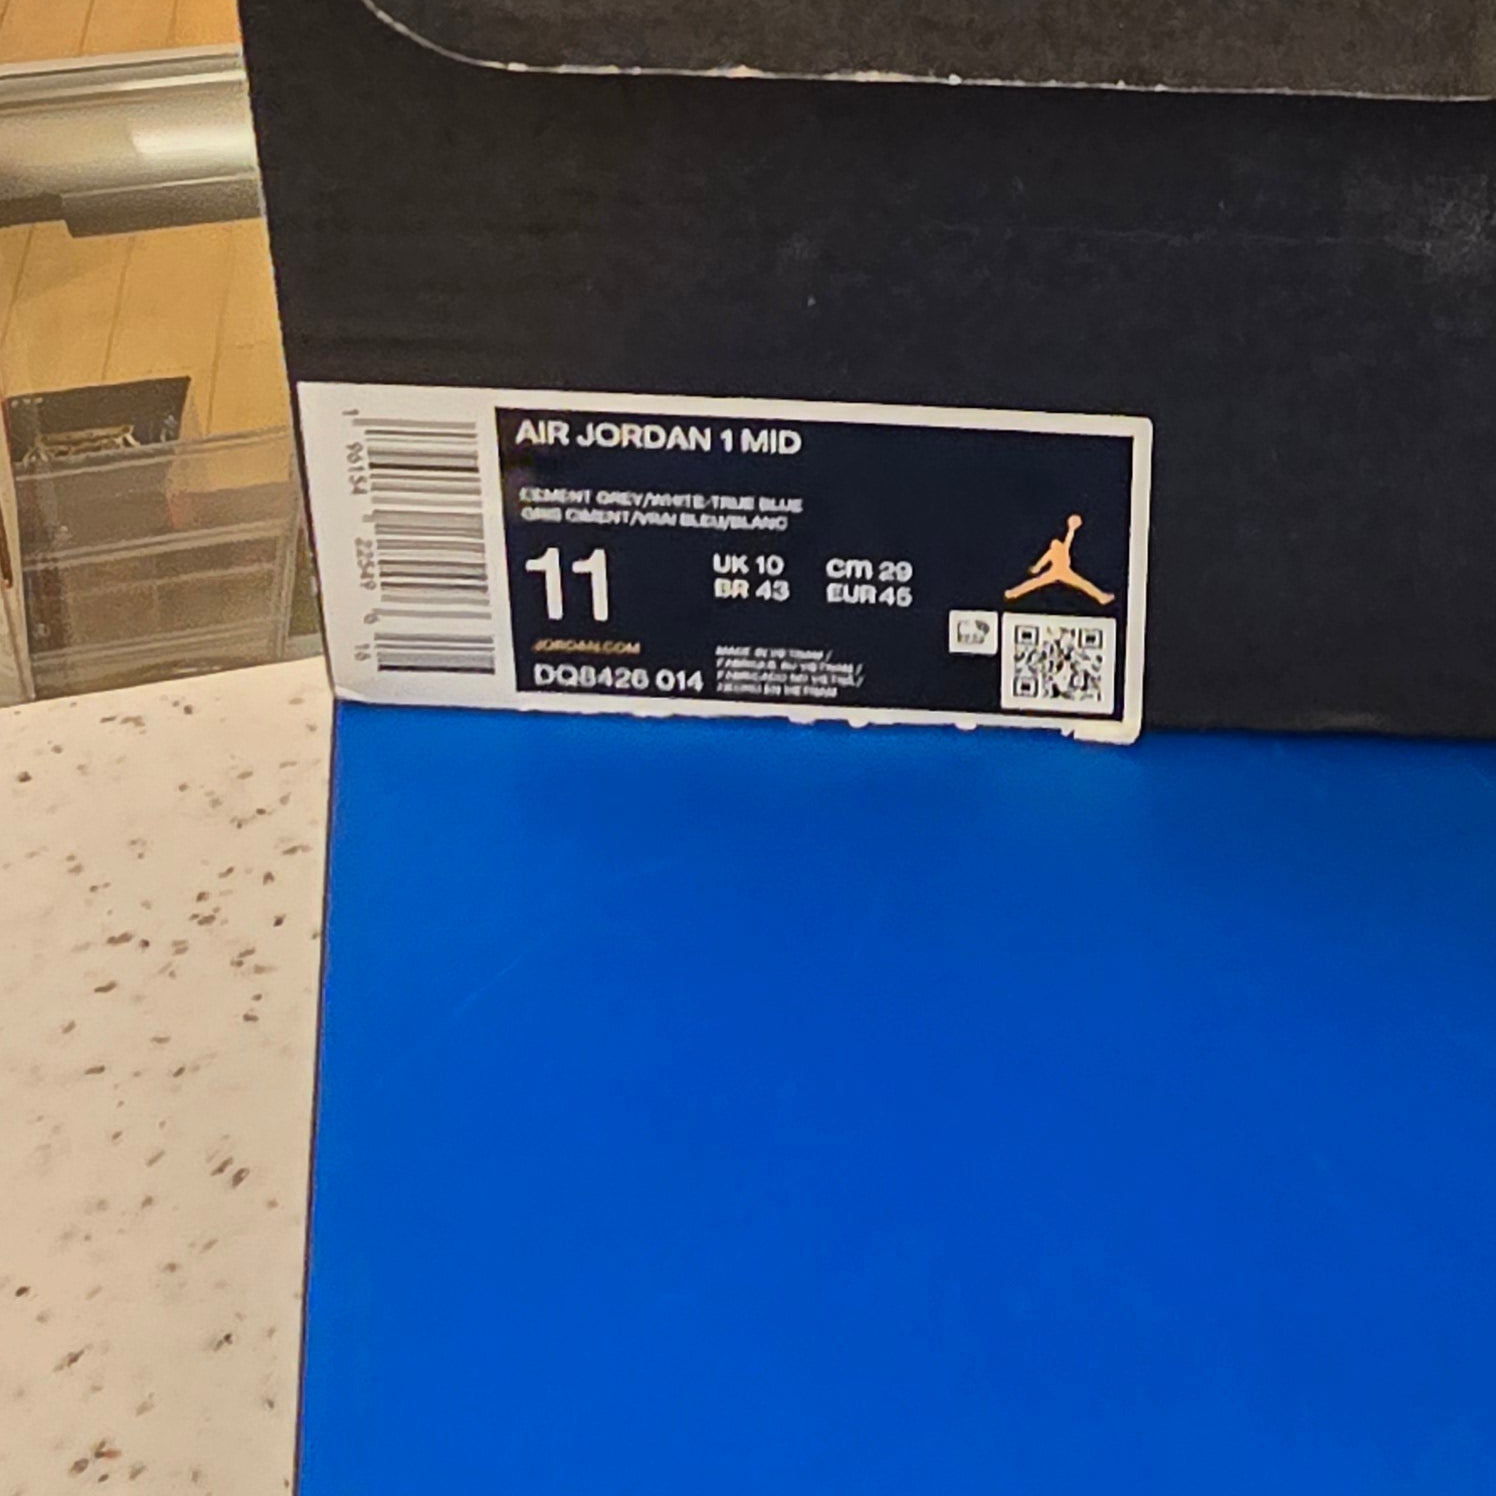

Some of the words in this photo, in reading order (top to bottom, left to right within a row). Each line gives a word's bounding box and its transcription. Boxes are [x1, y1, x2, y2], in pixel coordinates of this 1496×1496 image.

[515, 418, 569, 446] AIR
[576, 422, 711, 452] JORDAN
[720, 428, 733, 453] 1
[741, 428, 802, 454] MID
[713, 553, 749, 574] UK
[755, 555, 785, 576] 10
[878, 561, 913, 583] 29
[525, 547, 609, 622] 11
[714, 578, 749, 598] BR
[755, 580, 790, 602] 43
[826, 583, 877, 604] EUR
[533, 638, 641, 655] JORDAN.COM
[533, 663, 650, 690] DQ8426
[655, 668, 704, 692] 014
